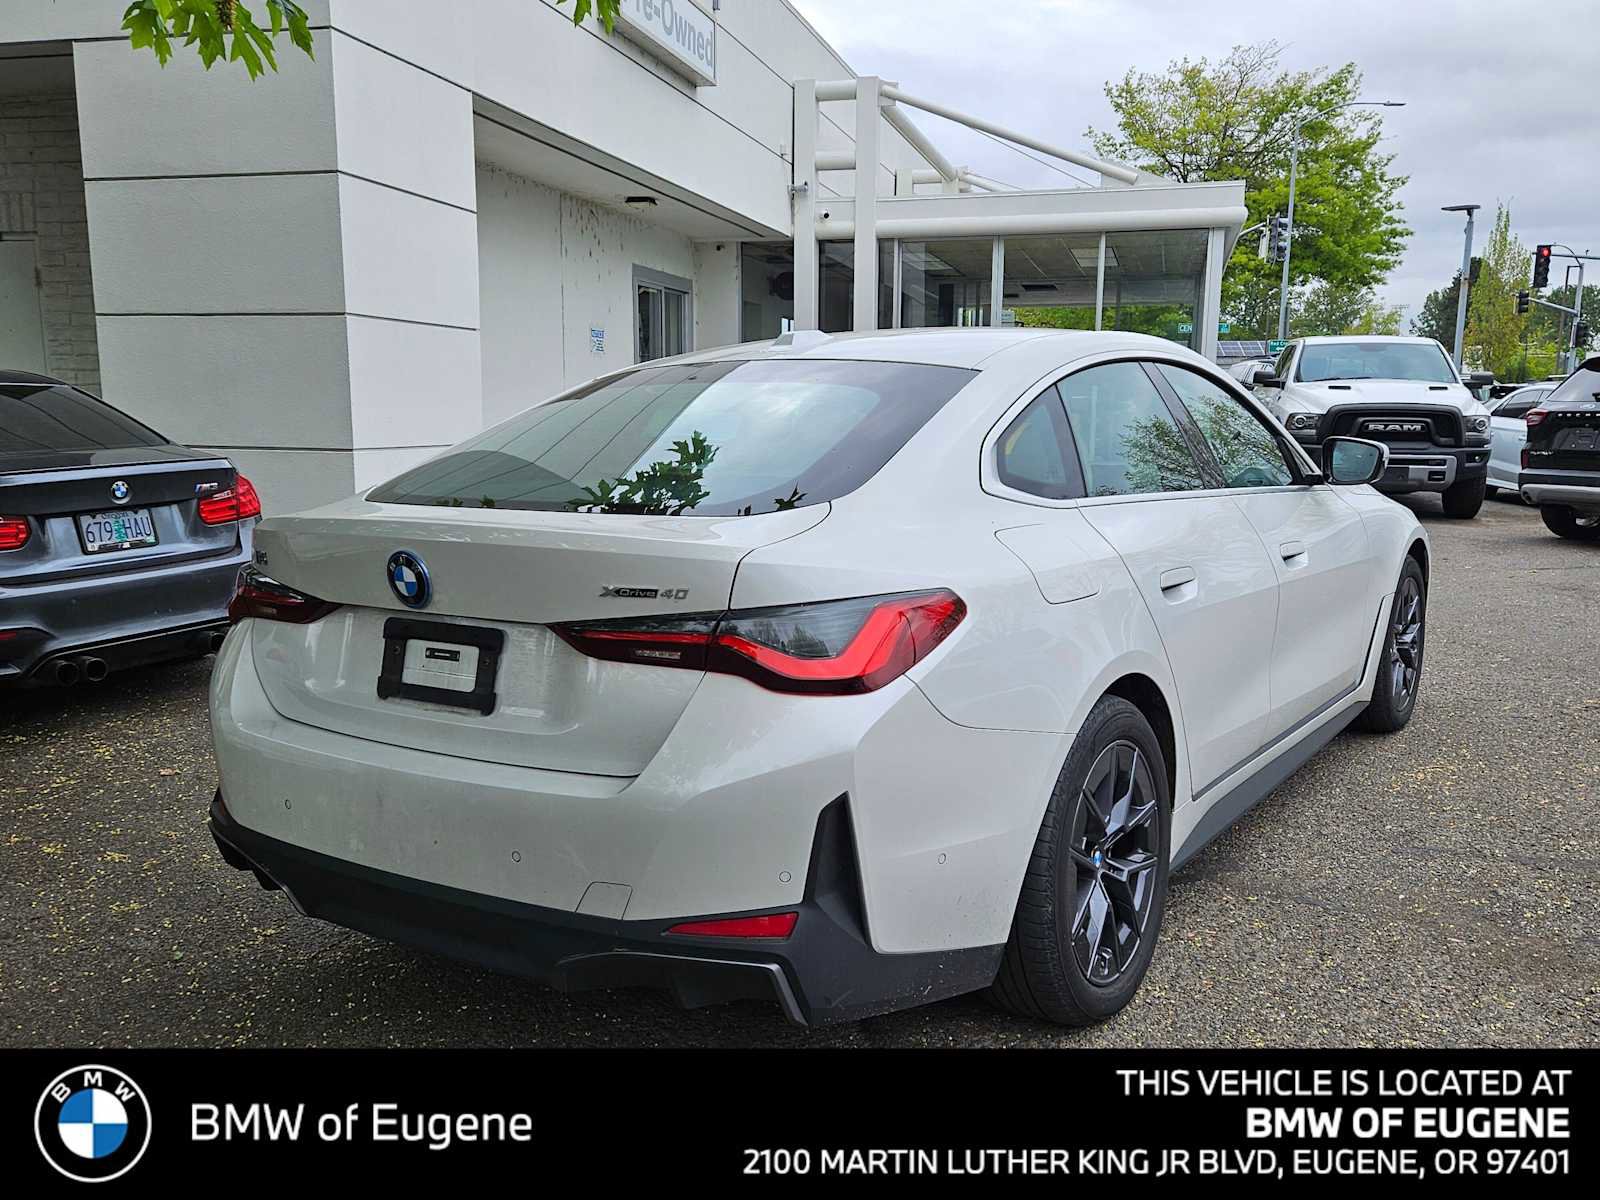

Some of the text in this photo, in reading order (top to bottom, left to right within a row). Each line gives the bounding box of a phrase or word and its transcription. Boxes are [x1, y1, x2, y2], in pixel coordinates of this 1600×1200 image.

[624, 0, 714, 68] e-Owned
[86, 516, 152, 543] 679 HAU
[660, 588, 688, 600] 40
